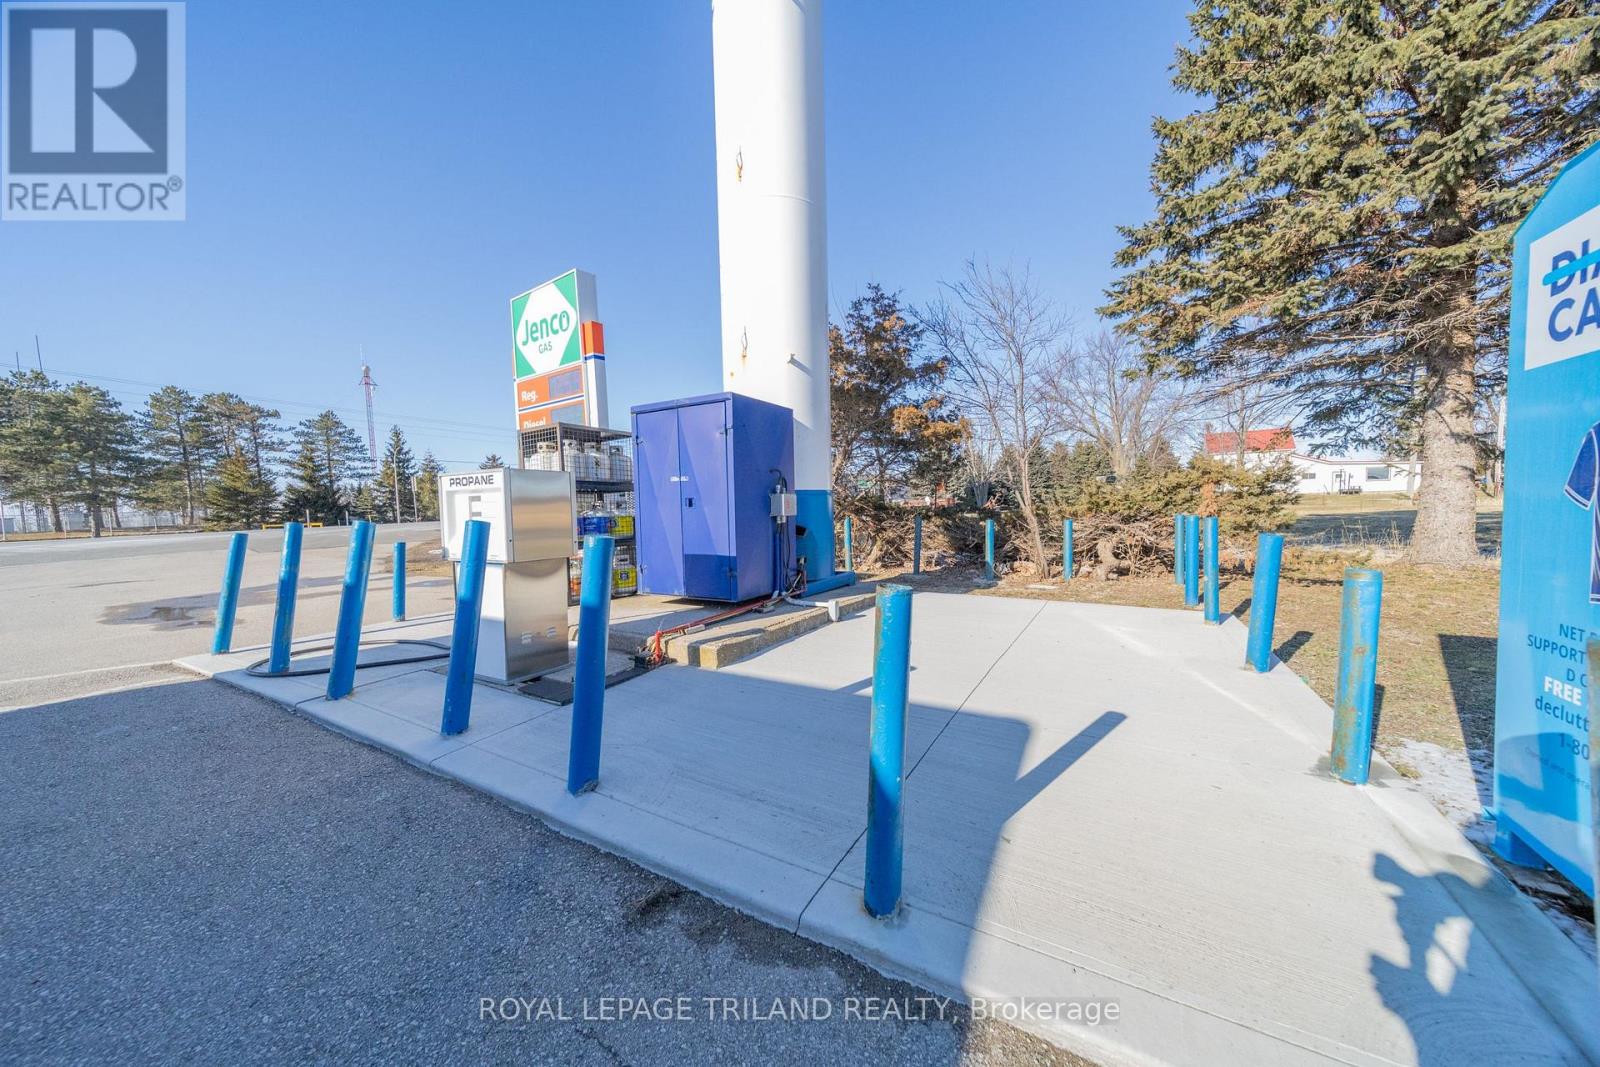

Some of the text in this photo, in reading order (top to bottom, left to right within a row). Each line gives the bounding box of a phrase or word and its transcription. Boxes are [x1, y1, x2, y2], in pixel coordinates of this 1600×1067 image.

[521, 310, 570, 346] Jenco
[538, 341, 553, 354] GAS
[449, 474, 495, 488] PROPANE
[1559, 623, 1586, 642] NET
[1527, 634, 1587, 664] SUPPORT
[1543, 675, 1582, 706] FREE
[1535, 695, 1590, 732] declutt
